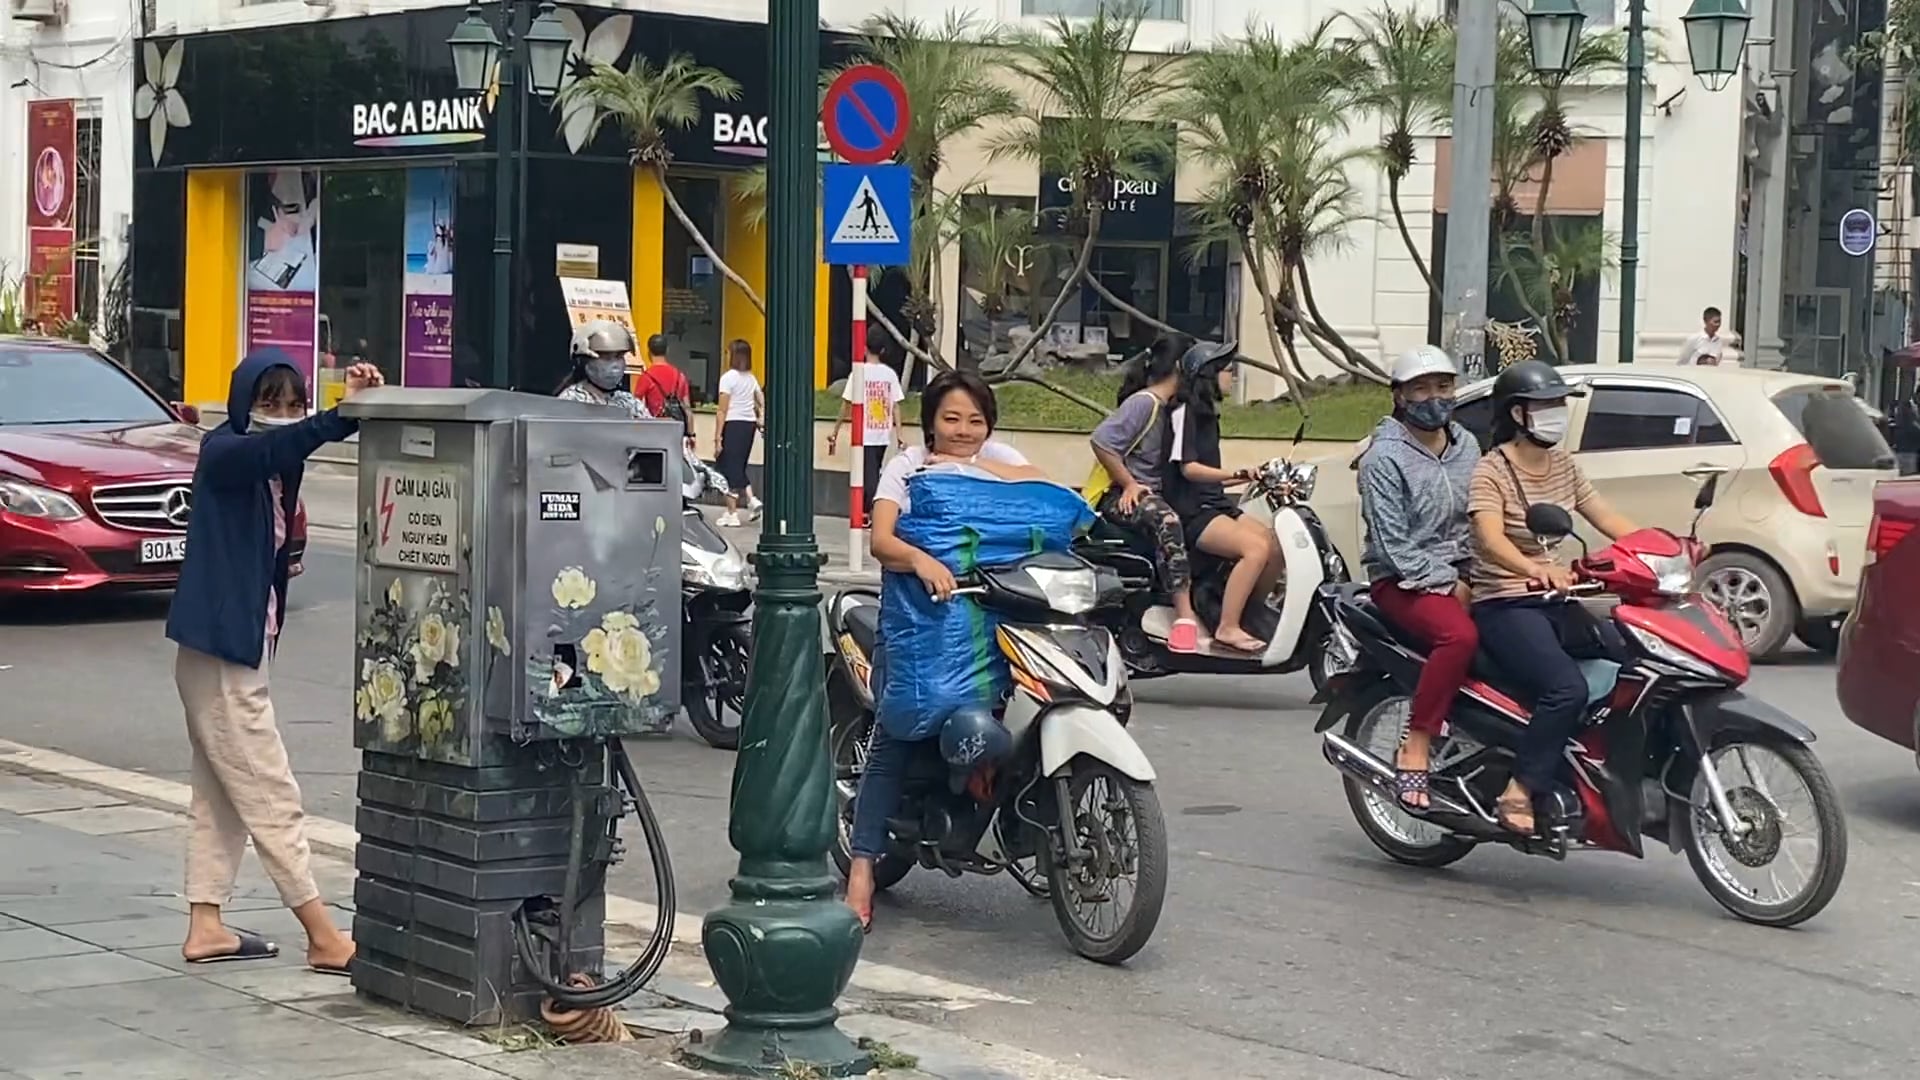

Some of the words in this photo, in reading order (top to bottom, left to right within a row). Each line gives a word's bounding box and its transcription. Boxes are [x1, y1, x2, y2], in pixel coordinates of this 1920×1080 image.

[353, 101, 398, 135] BAC
[400, 101, 419, 133] A
[421, 96, 485, 132] BANK
[1113, 179, 1157, 200] peau
[402, 530, 425, 545] NGUY
